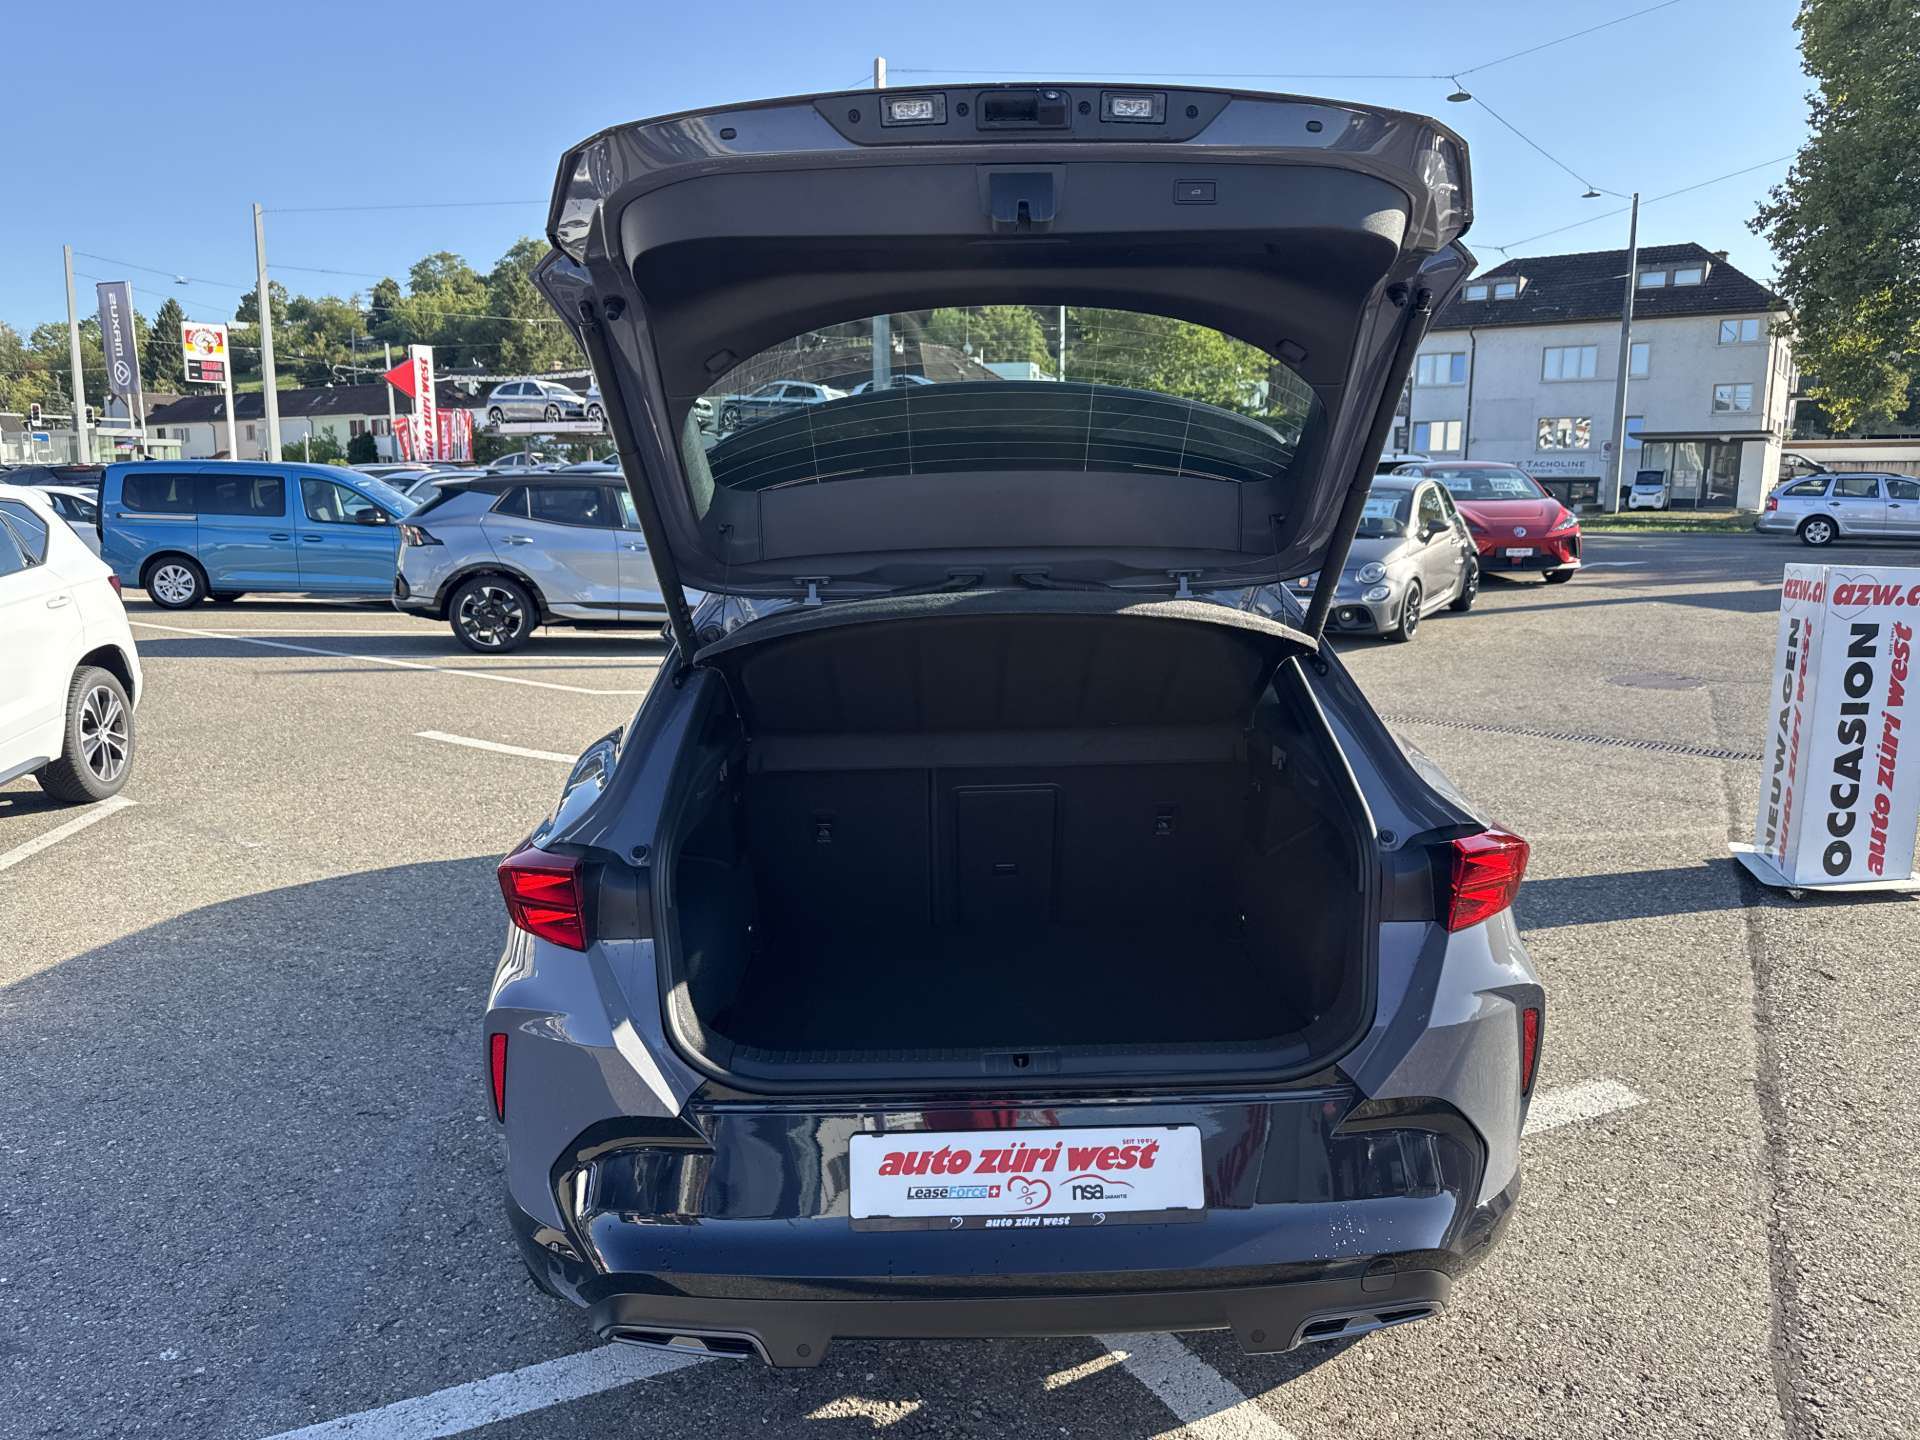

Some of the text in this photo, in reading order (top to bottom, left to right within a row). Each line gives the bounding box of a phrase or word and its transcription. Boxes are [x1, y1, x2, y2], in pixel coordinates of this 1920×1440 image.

[419, 357, 430, 393] west
[1526, 460, 1585, 468] TACHOLINE
[1764, 617, 1801, 859] NEUWAGEN
[1778, 786, 1793, 871] auto
[1796, 615, 1812, 702] west
[1823, 623, 1880, 877] OCCASION
[1868, 620, 1913, 877] auto züri west
[878, 1139, 1160, 1177] auto züri west
[907, 1185, 988, 1200] LeaseForce
[1072, 1184, 1104, 1201] nsa
[985, 1215, 1071, 1228] auto züri west
